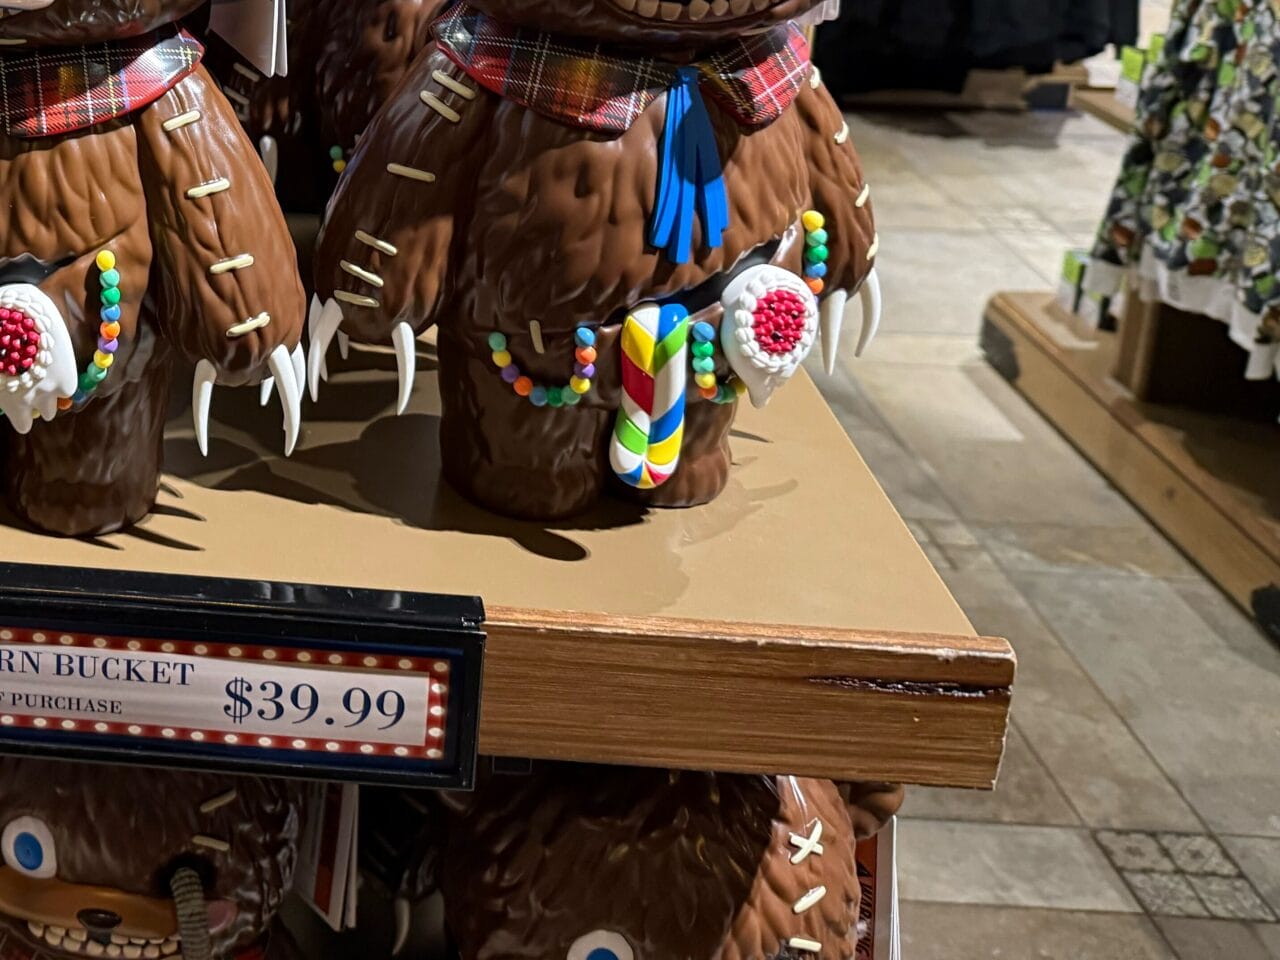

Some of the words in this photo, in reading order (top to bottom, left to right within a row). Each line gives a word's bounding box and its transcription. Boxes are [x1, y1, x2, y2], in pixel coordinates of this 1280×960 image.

[53, 652, 195, 686] BUCKET
[11, 692, 123, 715] PURCHASE
[223, 676, 406, 731] $39.99
